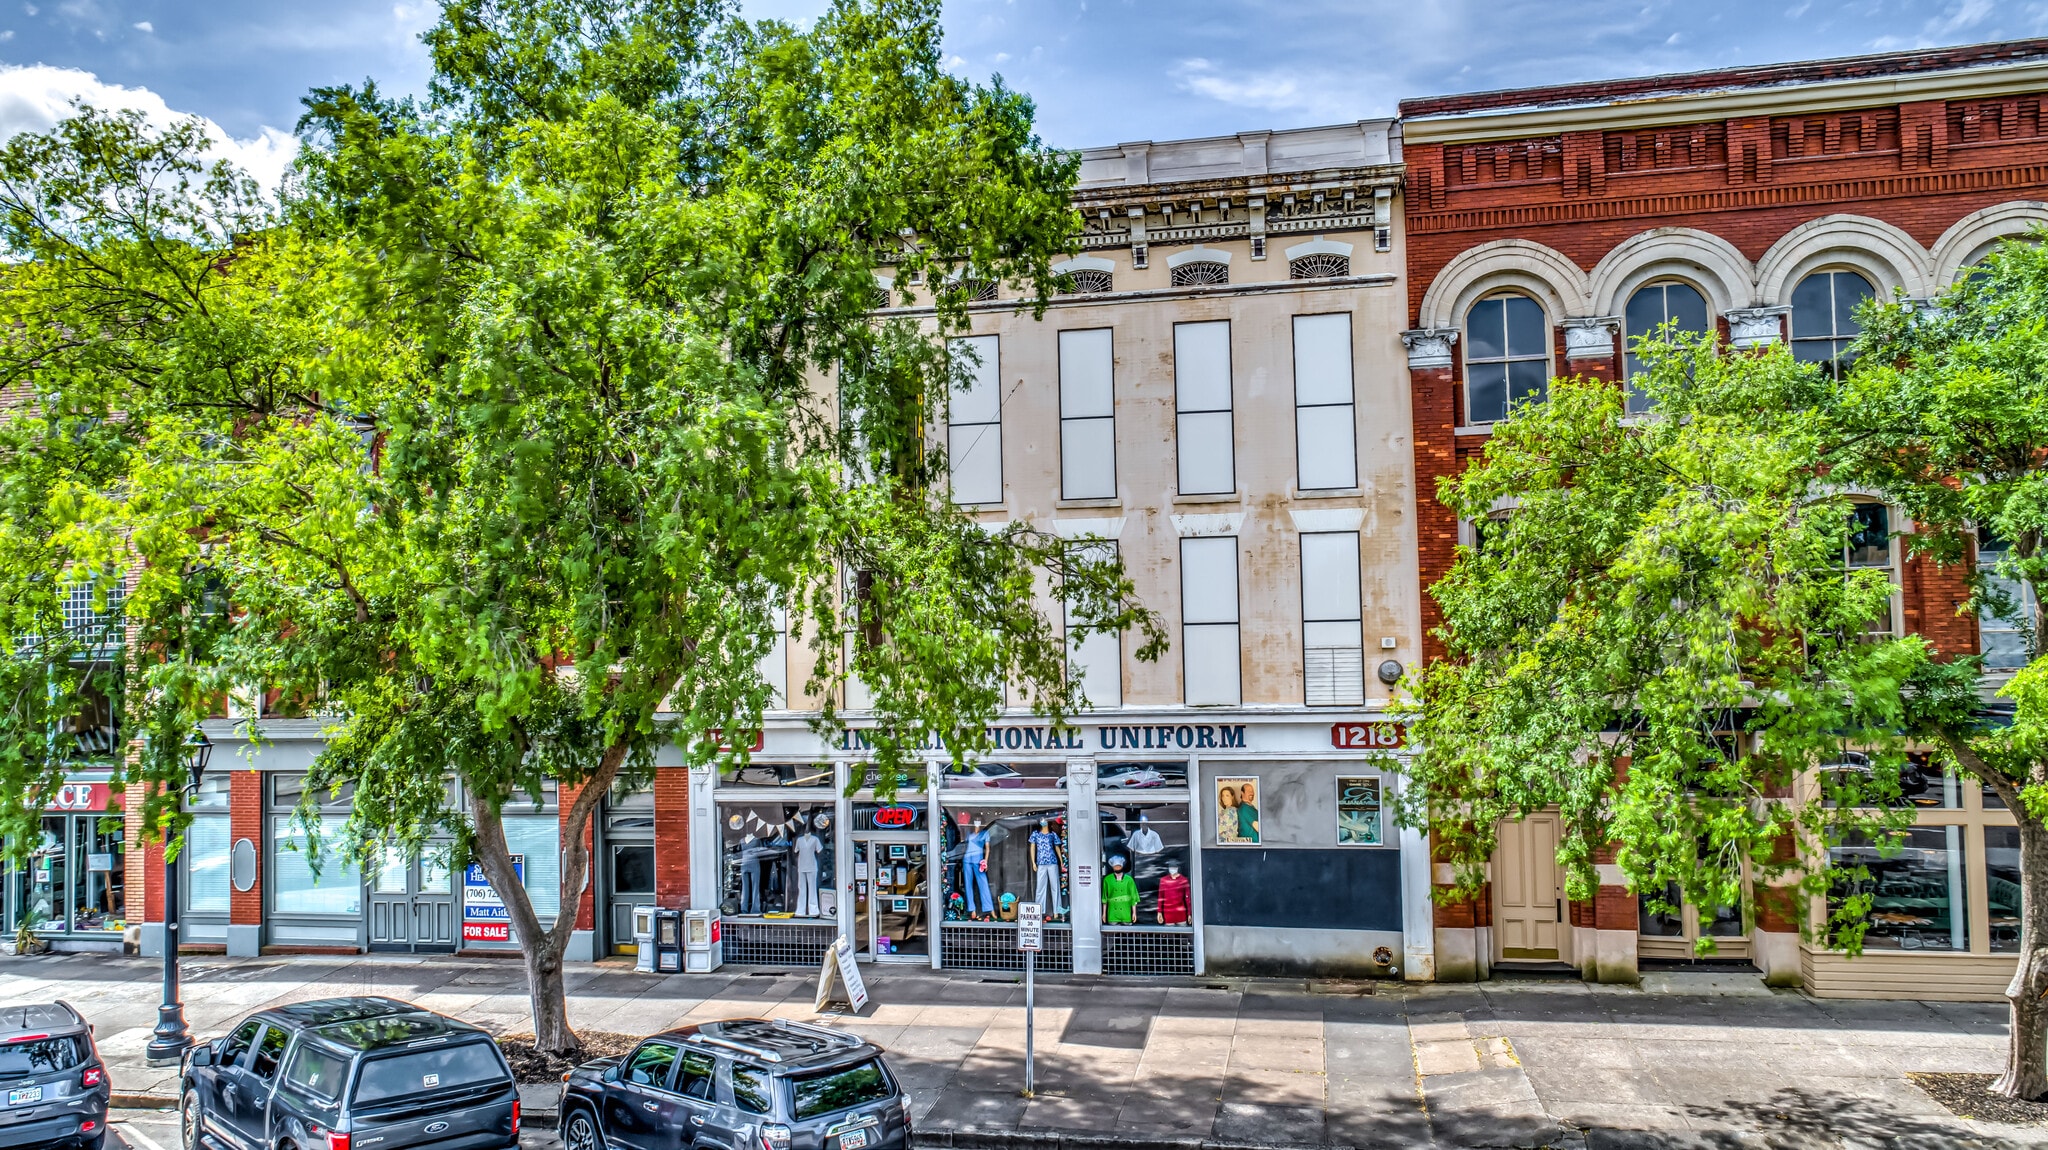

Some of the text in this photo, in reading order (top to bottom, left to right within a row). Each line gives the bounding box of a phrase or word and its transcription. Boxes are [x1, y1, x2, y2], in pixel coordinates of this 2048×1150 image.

[841, 725, 1246, 750] INRIONAL UNIFORM
[1338, 726, 1398, 746] 1218
[865, 771, 908, 781] cheee
[876, 808, 913, 824] OPEN
[466, 889, 486, 899] (706)
[470, 907, 509, 917] Matt Aitk
[464, 926, 507, 937] FOR SALE
